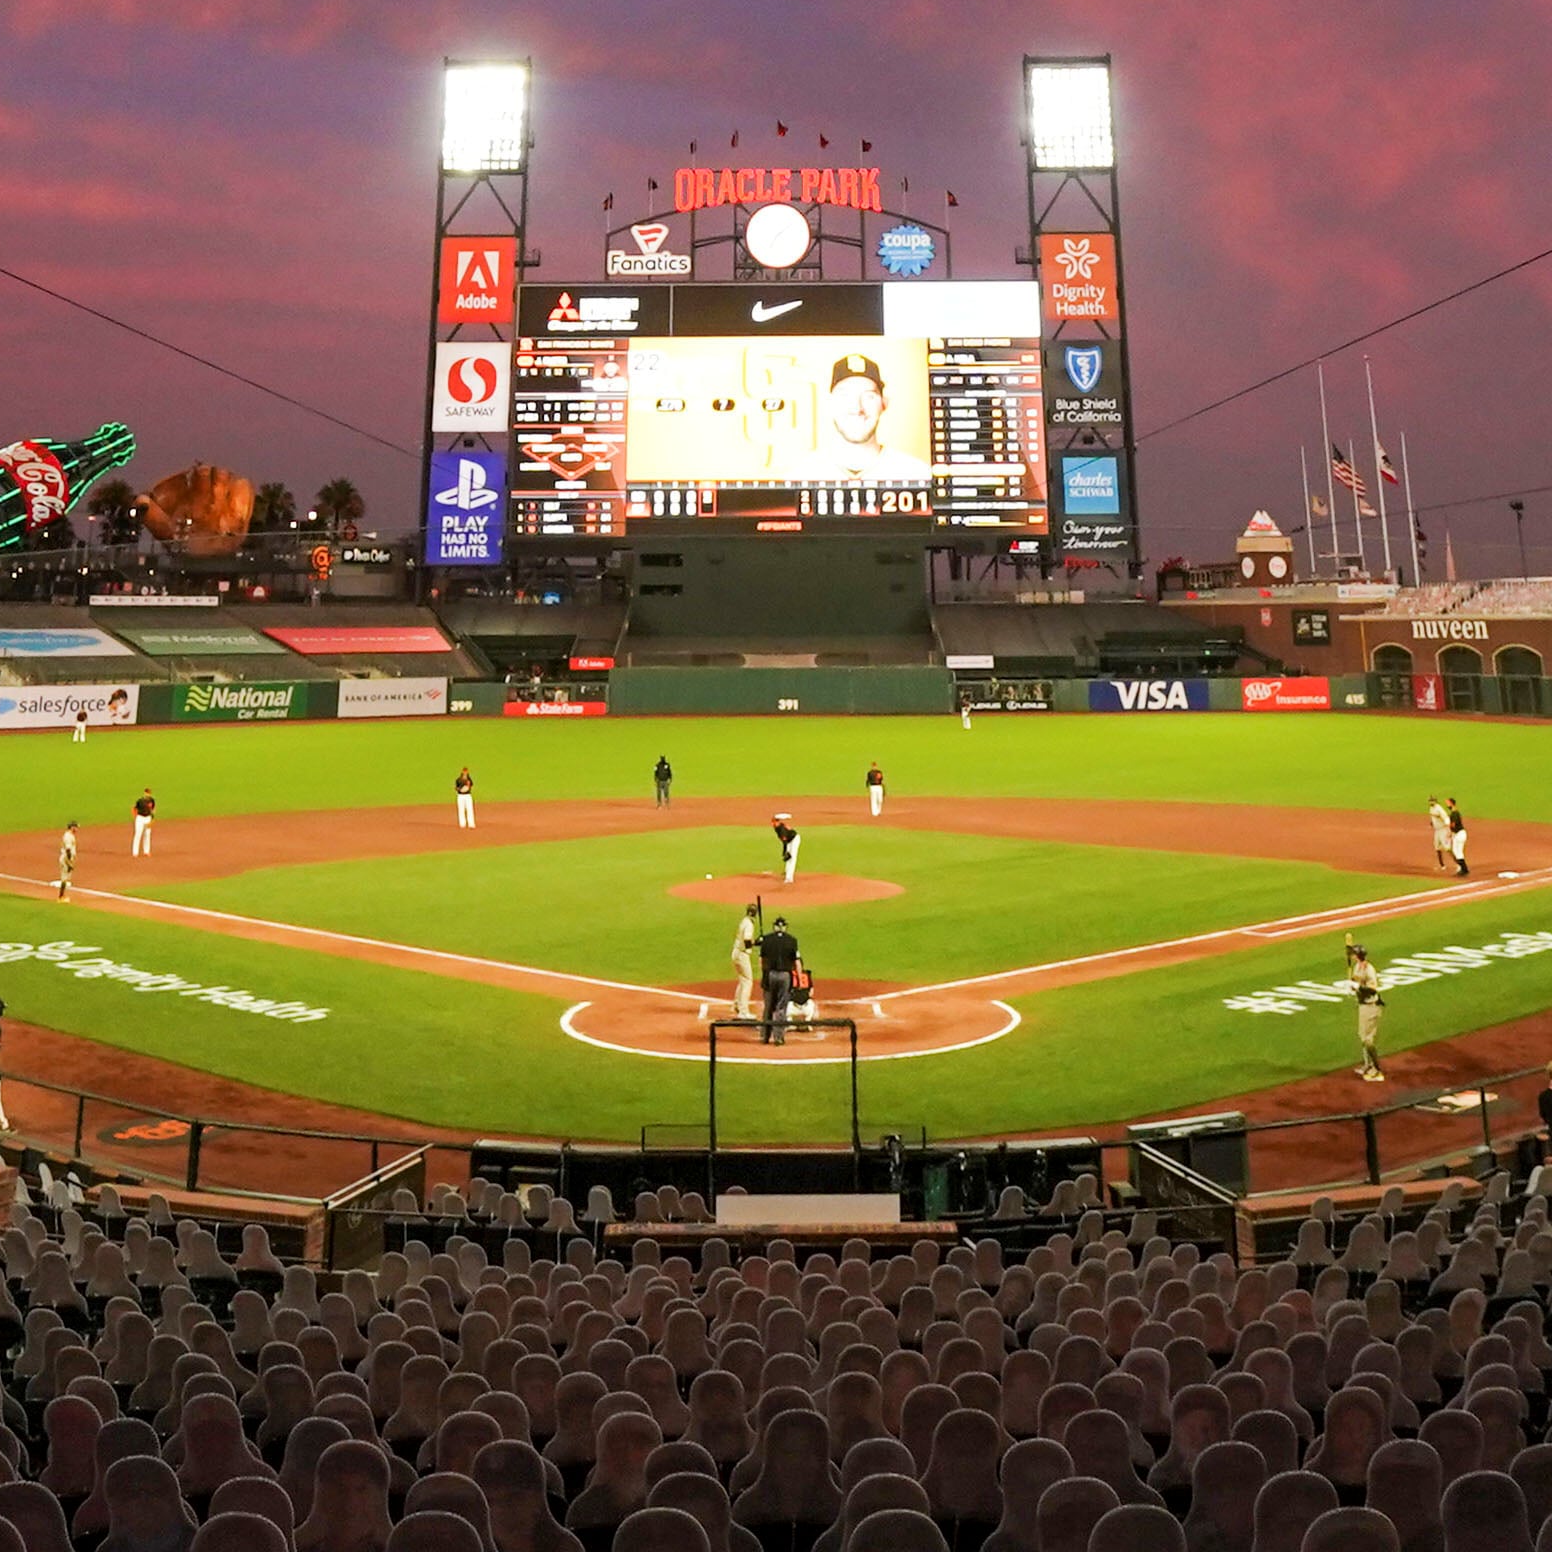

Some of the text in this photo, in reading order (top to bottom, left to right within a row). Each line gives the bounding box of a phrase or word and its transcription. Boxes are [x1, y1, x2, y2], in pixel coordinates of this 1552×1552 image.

[674, 167, 884, 213] ORACLE PARK
[884, 233, 932, 249] coupa
[611, 254, 688, 272] Fanatics
[1053, 284, 1105, 301] Dignity
[456, 293, 497, 309] Adobe
[1056, 301, 1105, 316] Health
[1056, 398, 1116, 410] Blue Shield
[445, 406, 496, 417] SAFEWAY
[1053, 411, 1121, 423] of California
[1069, 472, 1113, 486] charles
[1069, 488, 1113, 497] SCHWAB
[442, 516, 489, 533] PLAY
[441, 533, 488, 544] HAS NO
[1412, 620, 1489, 640] nuveen
[210, 685, 294, 709] National
[345, 692, 423, 703] BANK OF AMERICA
[1110, 681, 1189, 710] VISA
[1276, 695, 1327, 705] Insurance
[1346, 693, 1365, 705] 415
[18, 695, 106, 717] salesforce
[451, 701, 473, 712] 399
[778, 698, 799, 711] 391
[237, 708, 289, 720] Car Rental
[56, 958, 330, 1023] Dignity Health
